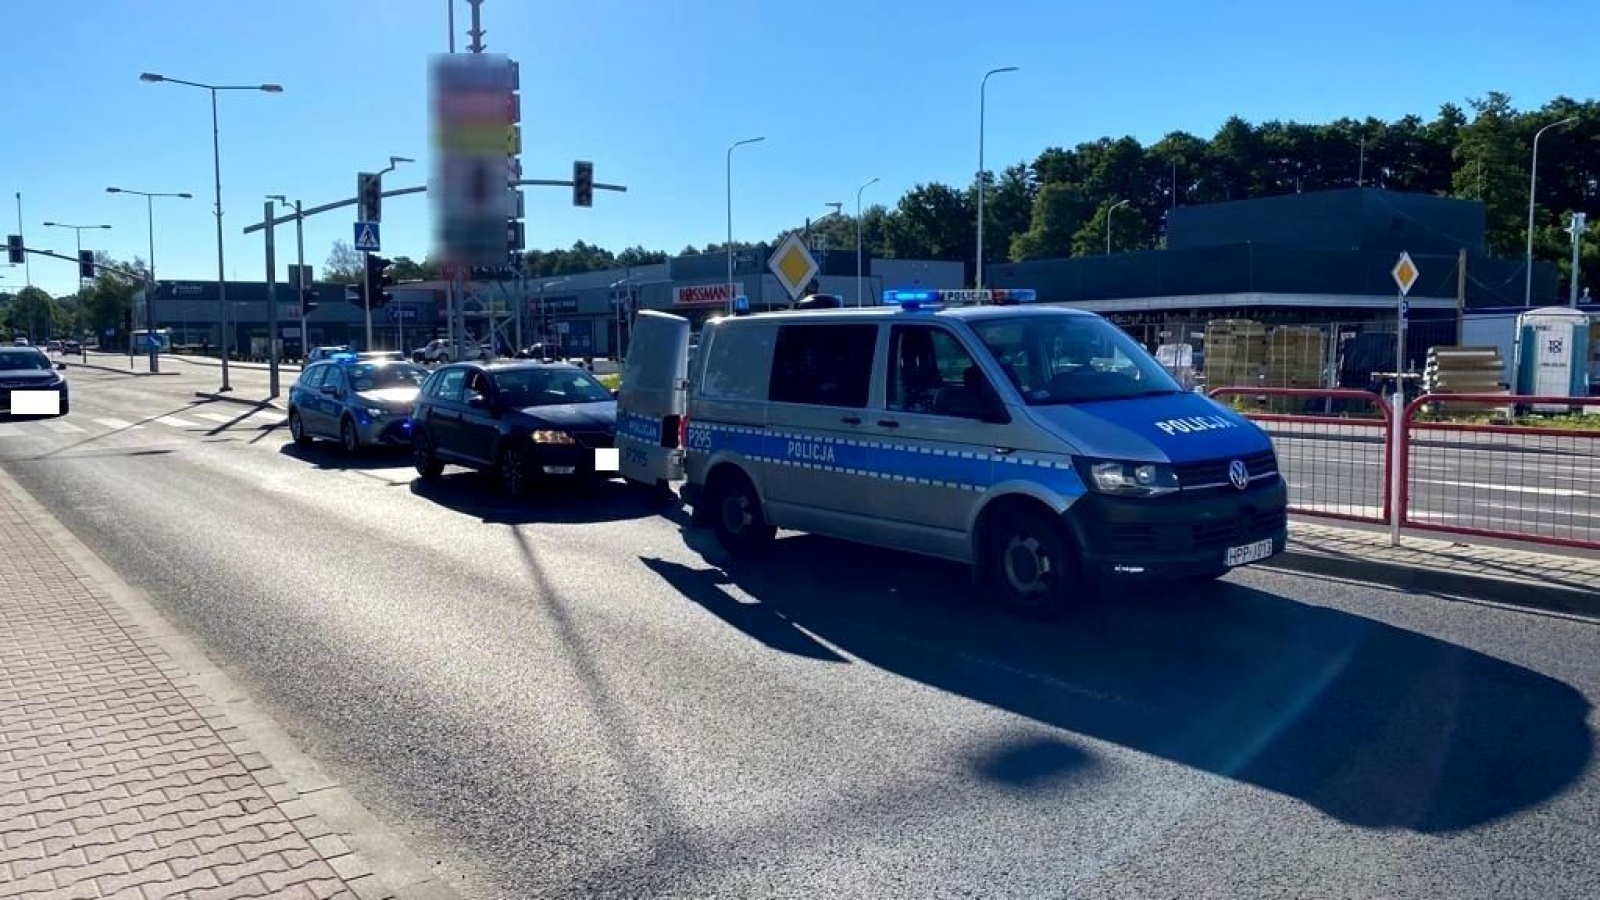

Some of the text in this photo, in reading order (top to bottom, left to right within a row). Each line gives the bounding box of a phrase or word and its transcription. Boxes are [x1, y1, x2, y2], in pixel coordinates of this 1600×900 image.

[679, 284, 735, 300] ROSSMANN
[948, 291, 989, 301] POLICJA
[1154, 415, 1239, 436] POLICJA
[688, 429, 712, 448] P295
[787, 440, 835, 462] POLICJA
